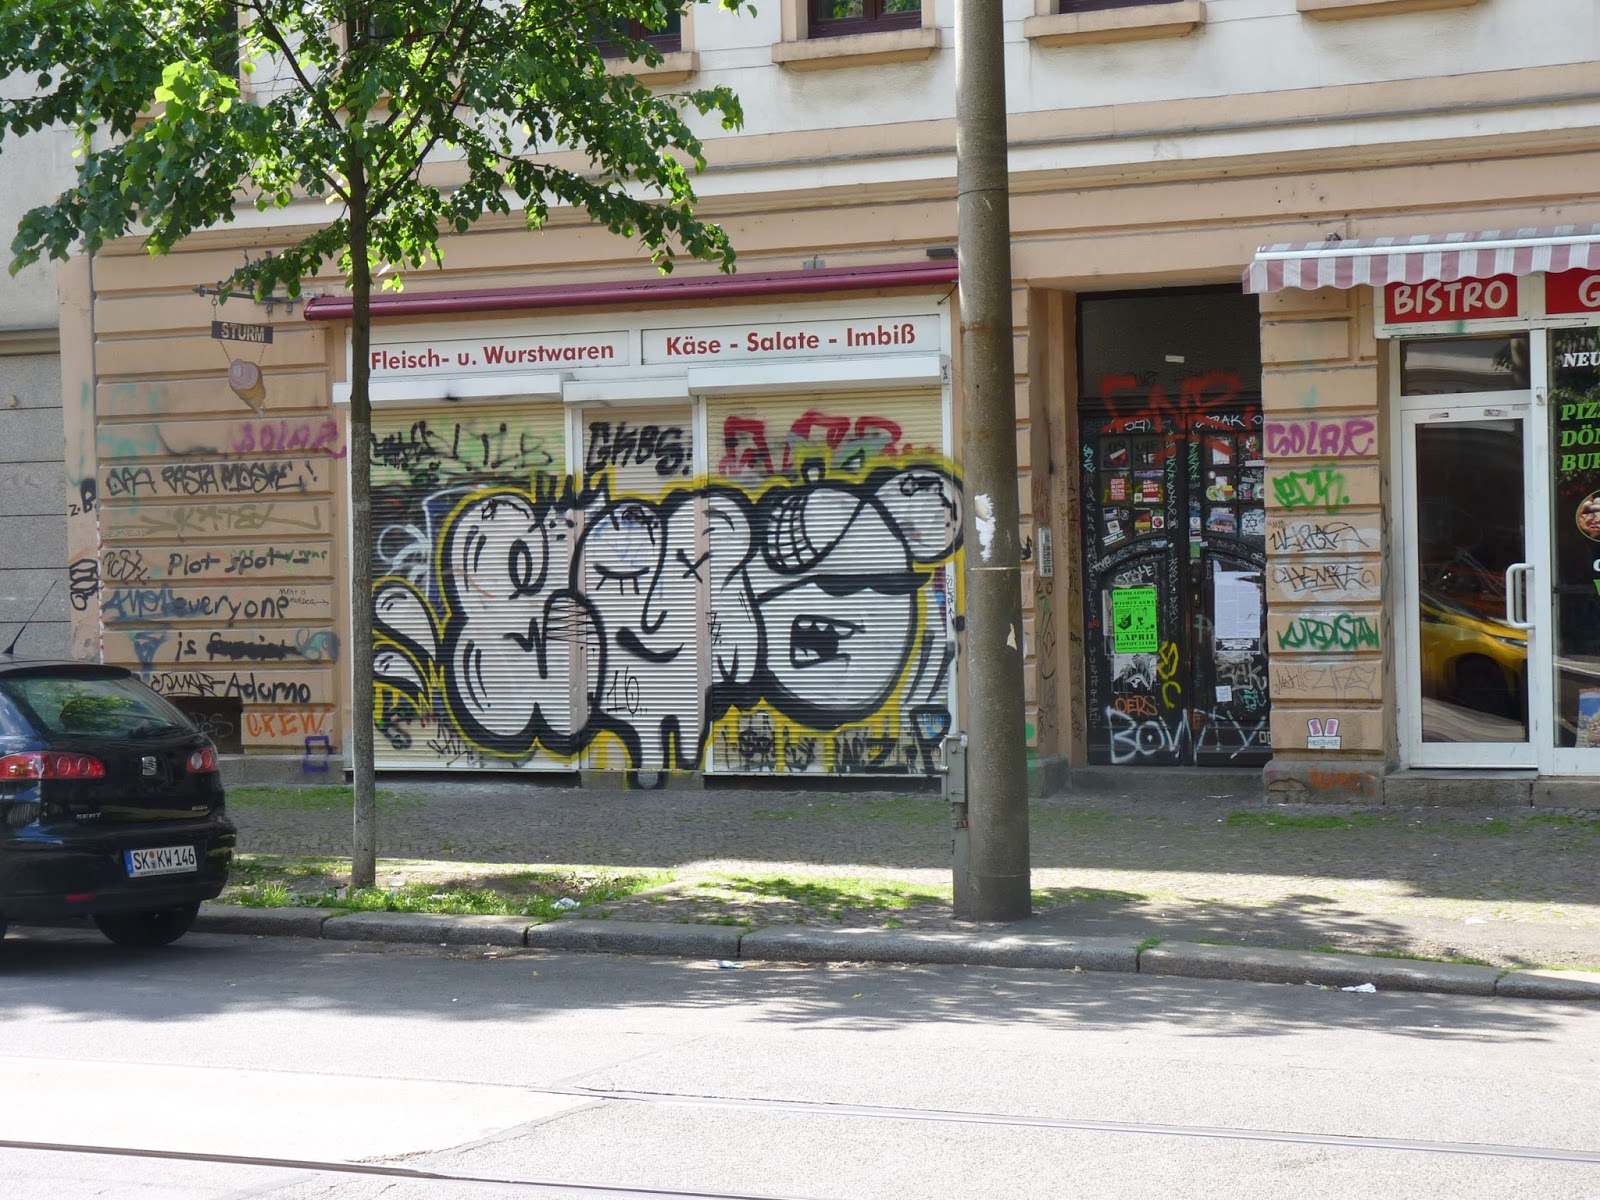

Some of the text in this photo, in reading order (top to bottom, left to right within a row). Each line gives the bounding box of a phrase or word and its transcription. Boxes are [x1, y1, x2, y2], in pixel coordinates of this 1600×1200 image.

[1394, 280, 1509, 315] BISTRO
[221, 322, 265, 343] STURM
[666, 335, 722, 356] Käse
[746, 330, 820, 352] Salate
[846, 323, 916, 347] Imbiß
[371, 344, 614, 370] Fleisch- u. Wurstwaren
[1561, 402, 1600, 421] PIZ
[174, 595, 289, 628] everyone
[1276, 613, 1380, 650] KURDISTAN
[175, 632, 197, 662] is
[133, 848, 195, 870] SK KW 146
